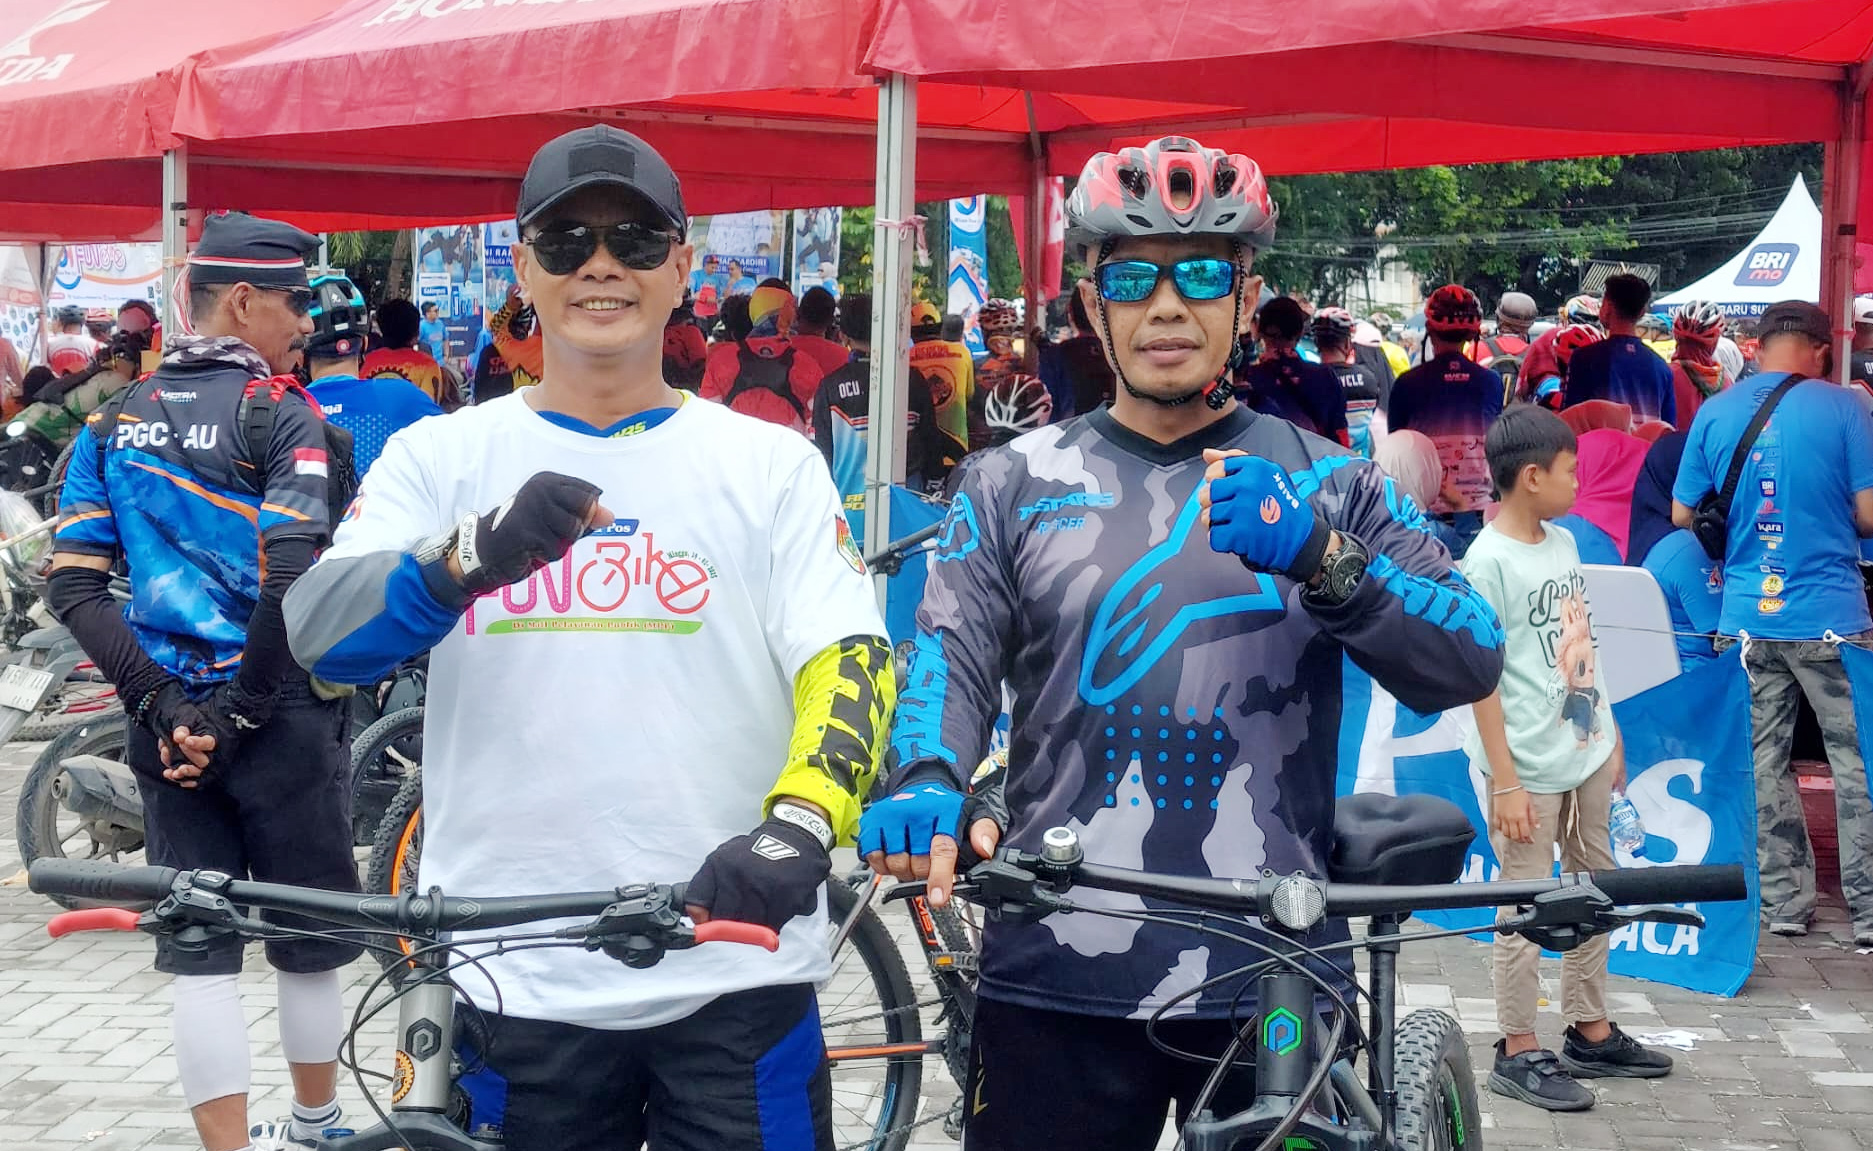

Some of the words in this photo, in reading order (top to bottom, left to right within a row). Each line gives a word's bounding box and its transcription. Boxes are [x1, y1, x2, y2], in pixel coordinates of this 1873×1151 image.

[1749, 252, 1791, 269] BRI
[1749, 269, 1782, 280] mo
[1339, 373, 1364, 387] YCLE
[117, 421, 169, 449] PGC
[182, 424, 218, 449] AU
[1036, 517, 1086, 535] RACER
[362, 901, 394, 909] ENTITY
